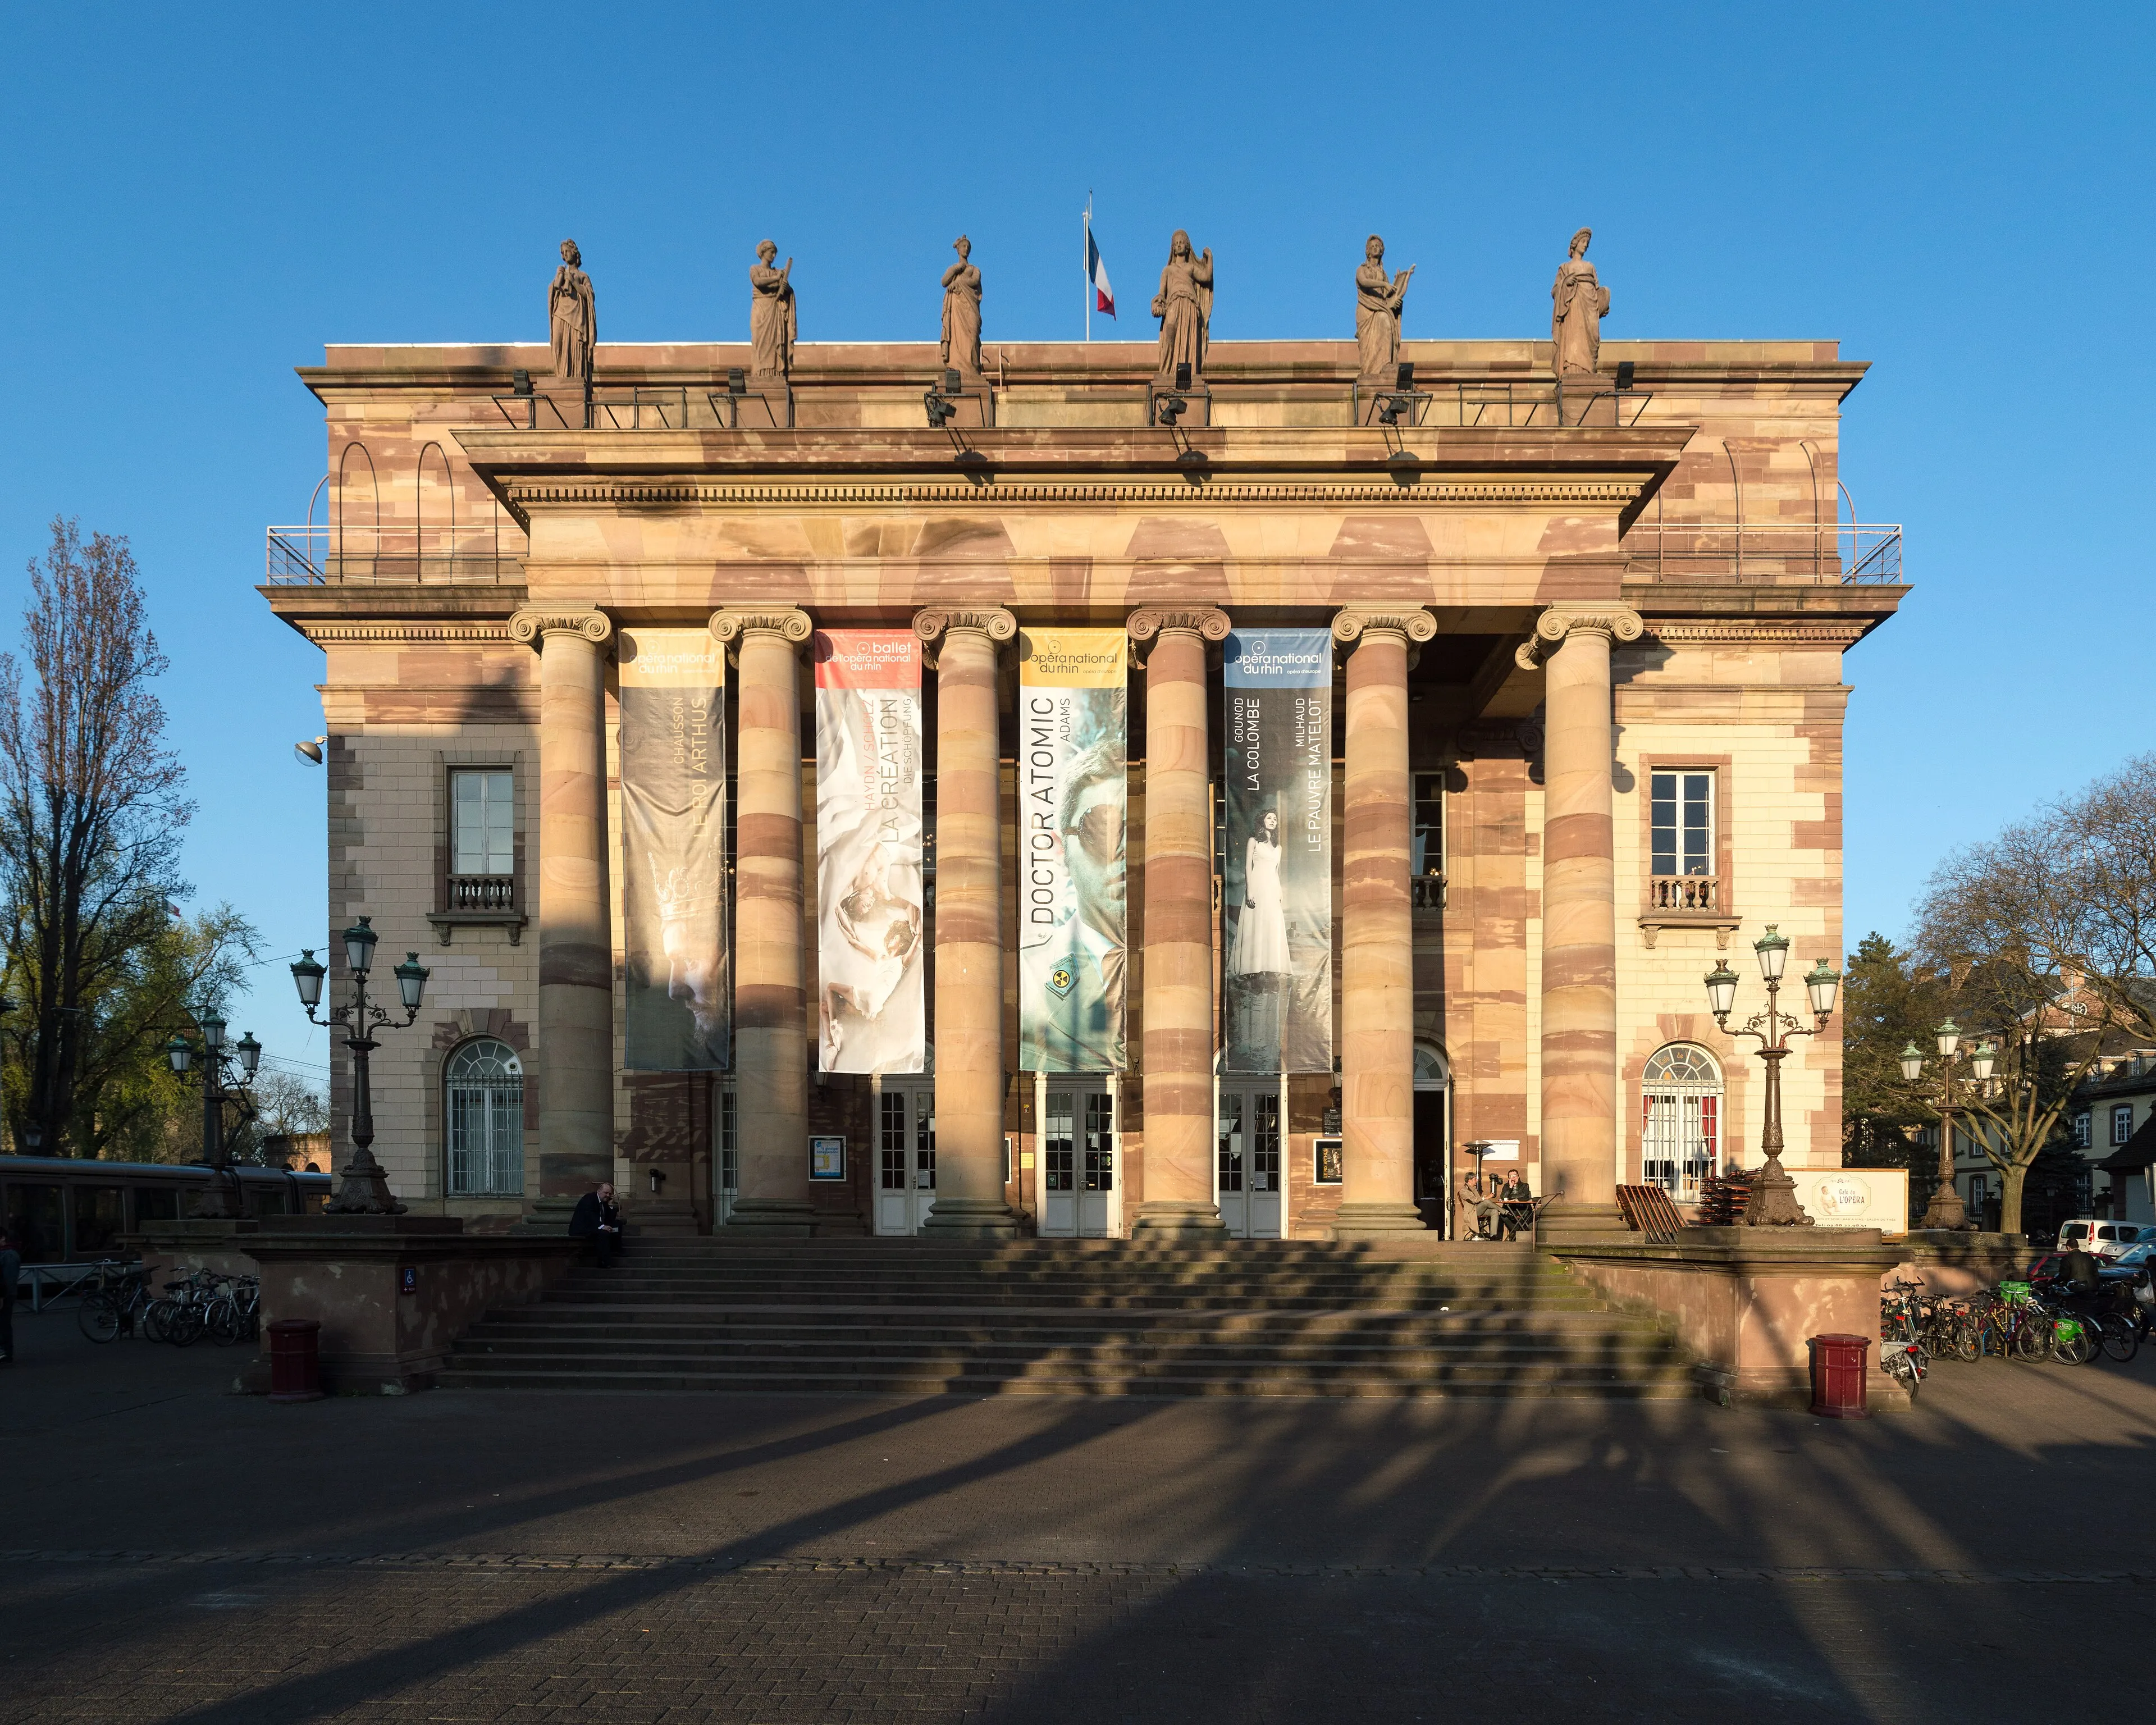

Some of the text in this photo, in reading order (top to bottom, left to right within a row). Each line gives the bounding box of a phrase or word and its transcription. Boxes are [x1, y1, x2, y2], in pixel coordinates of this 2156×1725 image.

[630, 652, 715, 665] opéra national
[639, 663, 678, 674] du rhin
[825, 654, 911, 665] de l'opéra national
[851, 662, 881, 670] du rhin
[873, 642, 911, 654] ballet
[1031, 653, 1117, 664] opéra national
[1040, 663, 1079, 673] du rhin
[1235, 653, 1322, 665] opéra national
[1244, 664, 1282, 674] du rhin
[673, 697, 684, 764] CHAUSSON
[863, 699, 875, 751] SCHOLZ
[902, 698, 912, 784] DIE SCHÖPFUNG
[1059, 697, 1070, 742] ADAMS
[1234, 697, 1244, 742] GOUNOD
[1295, 697, 1305, 747] MILHAUD
[1247, 698, 1259, 791] LA COLOMBE
[691, 697, 709, 838] LE ROI ARTHUS
[864, 765, 875, 811] HAYDN
[876, 699, 899, 842] LA CRÉATION
[1308, 698, 1321, 852] LE PAUVRE MATELOT
[1031, 698, 1054, 924] DOCTOR ATOMIC
[1839, 1194, 1865, 1204] L'OPÉRA
